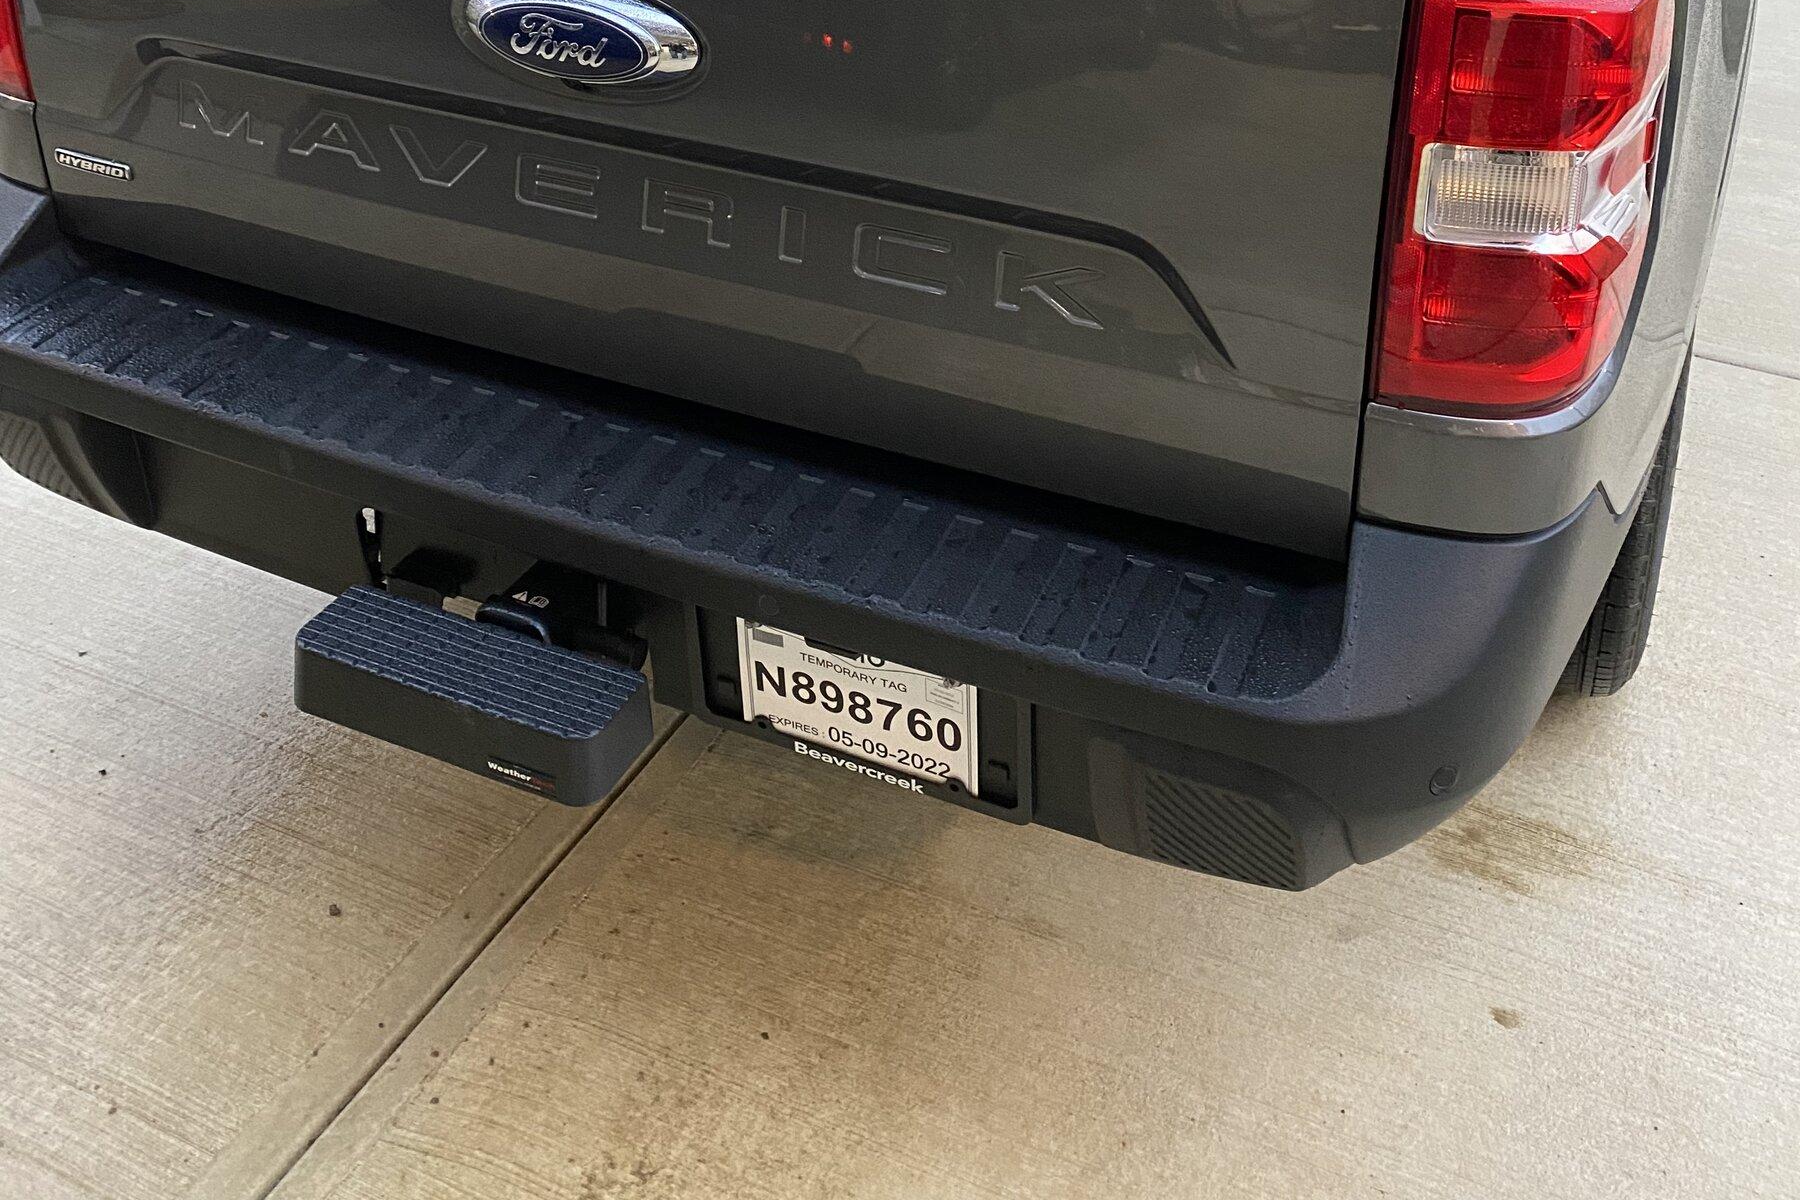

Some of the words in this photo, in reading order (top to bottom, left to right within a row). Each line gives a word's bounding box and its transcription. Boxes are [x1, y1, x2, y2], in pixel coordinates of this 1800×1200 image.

[510, 12, 608, 68] Ford
[59, 153, 123, 177] HYBRID
[178, 78, 1103, 330] MAVERICK
[800, 652, 877, 685] TEMPORARY
[881, 678, 907, 693] TAG
[754, 660, 962, 752] N898760
[794, 741, 925, 795] Beavercreek
[828, 725, 951, 778] 05-09-2022
